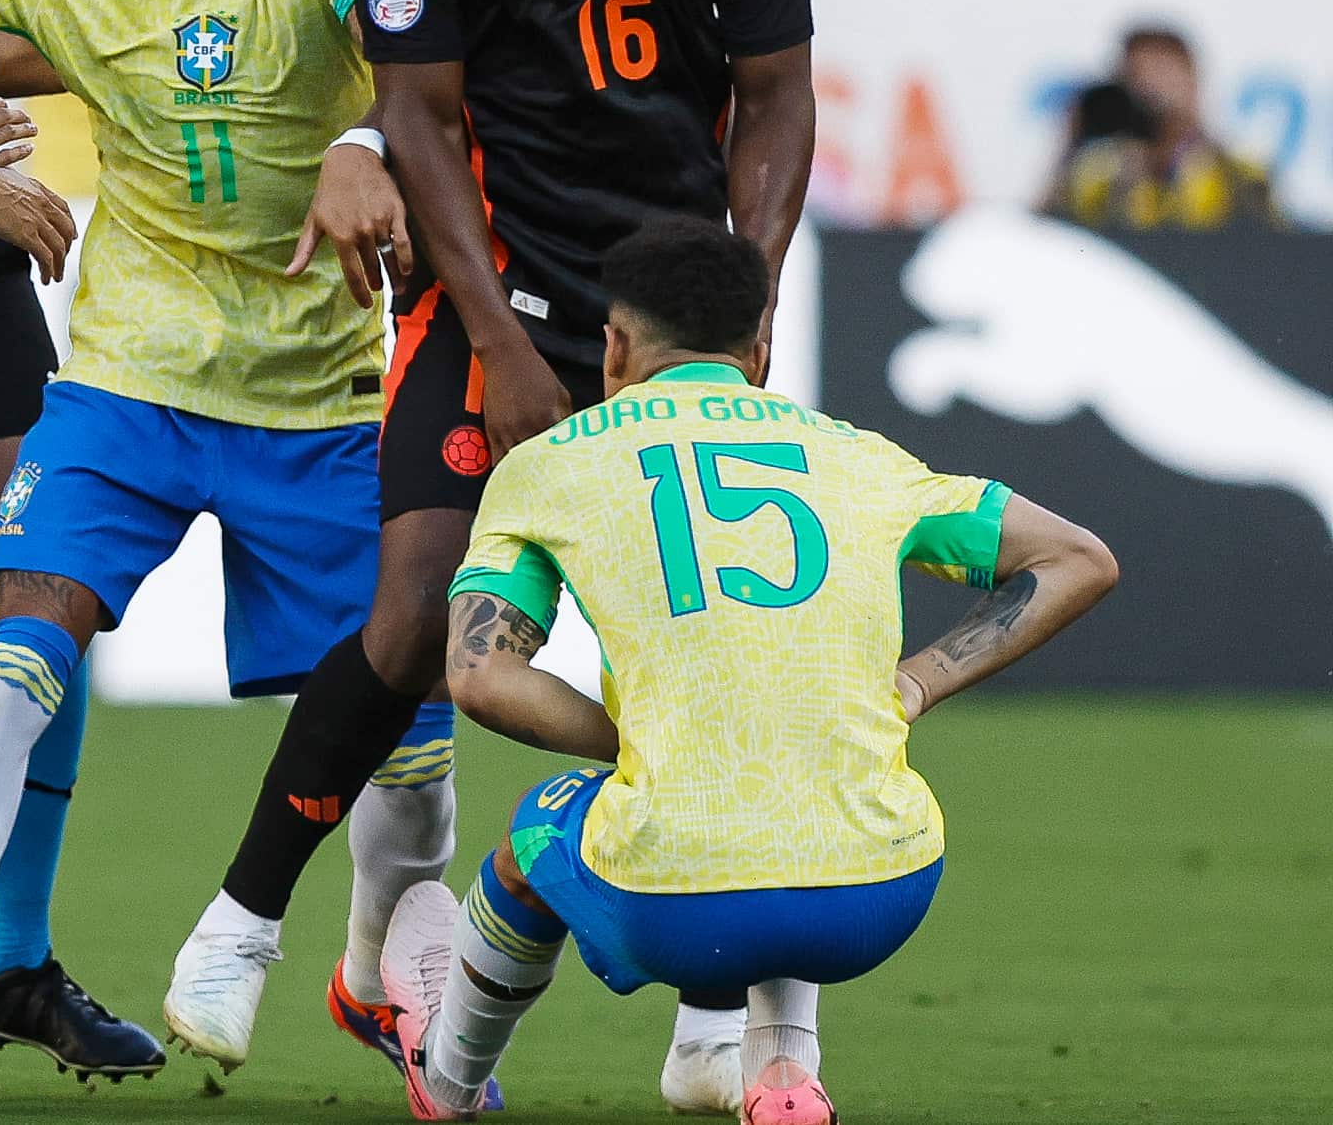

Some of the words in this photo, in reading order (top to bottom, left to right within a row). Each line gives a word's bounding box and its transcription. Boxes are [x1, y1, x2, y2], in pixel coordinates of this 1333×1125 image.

[193, 45, 218, 56] CBF
[174, 90, 239, 105] BRASIL
[180, 122, 239, 204] 11
[638, 441, 829, 618] 15
